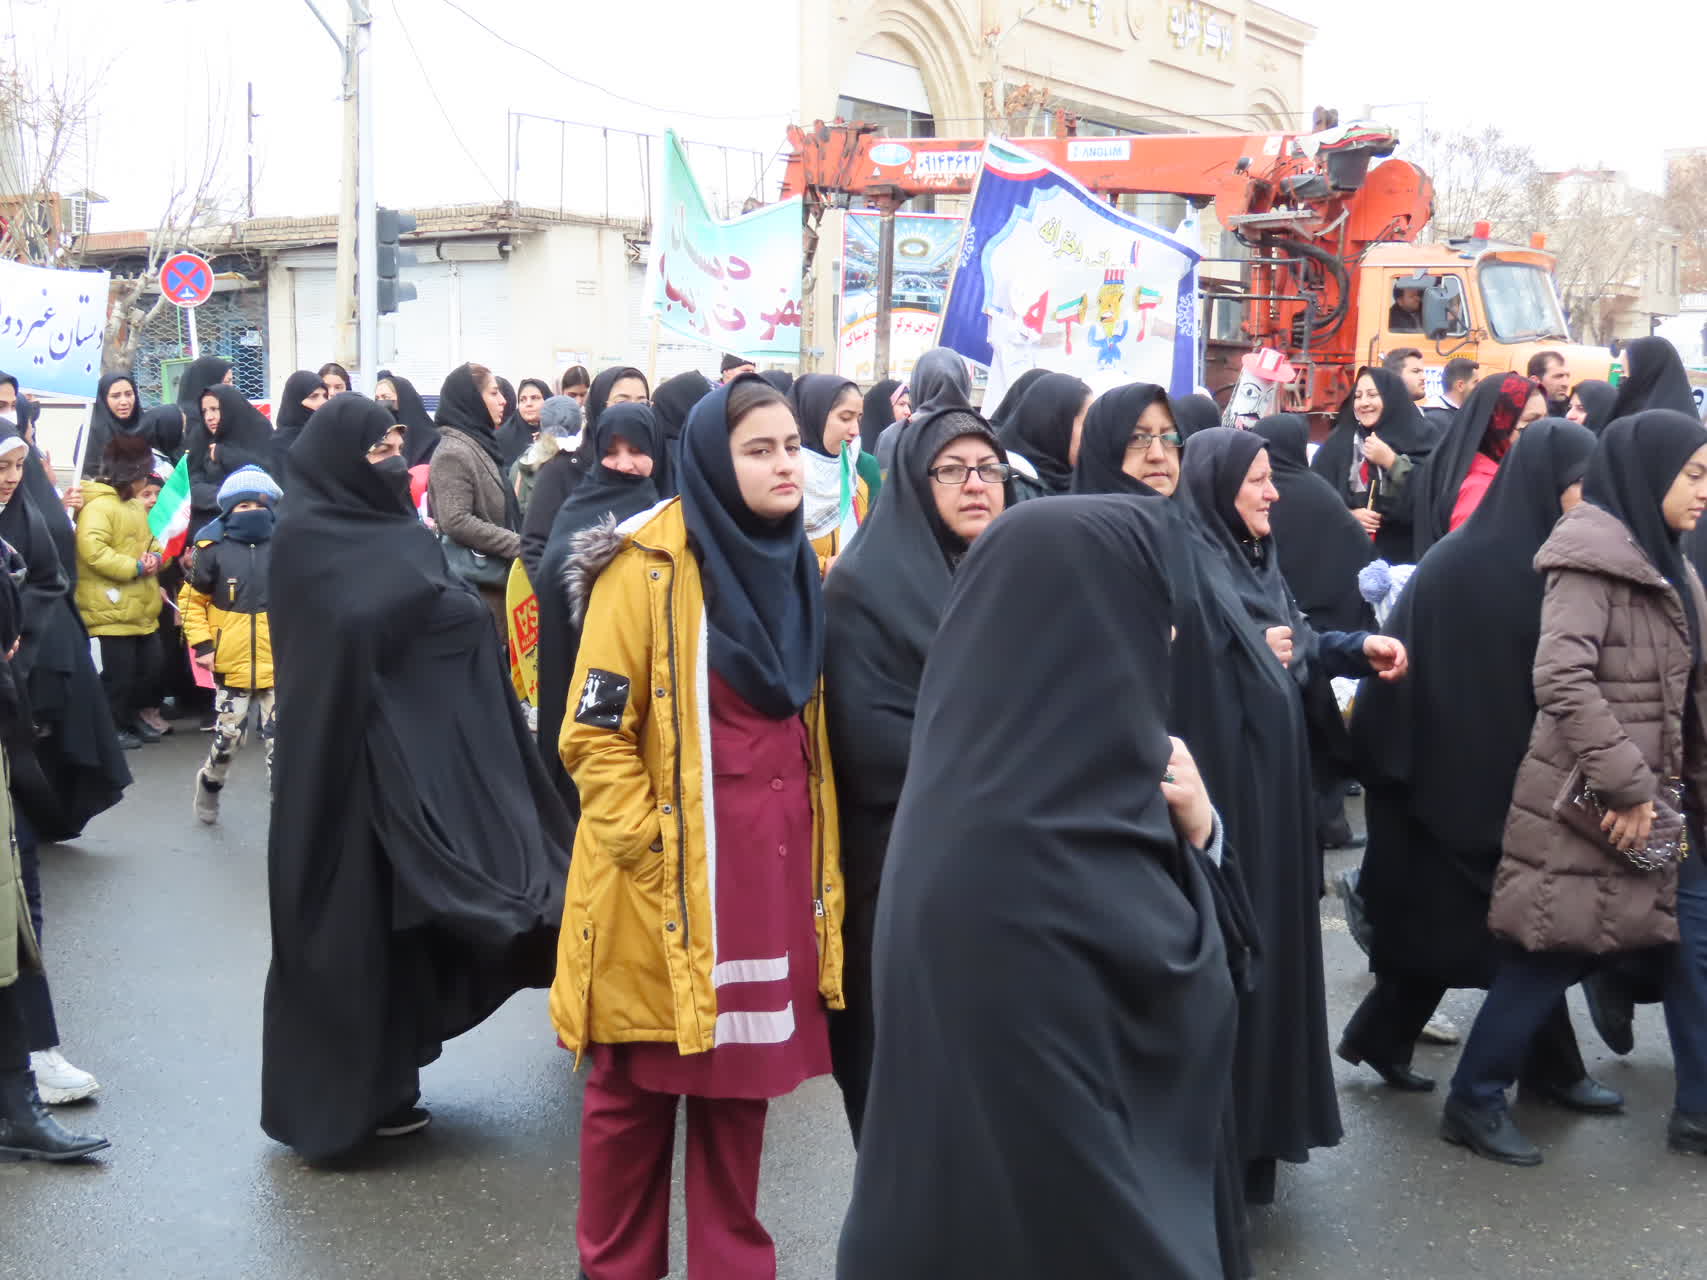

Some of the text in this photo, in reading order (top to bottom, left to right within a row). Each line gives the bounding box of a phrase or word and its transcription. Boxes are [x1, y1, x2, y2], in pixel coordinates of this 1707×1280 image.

[0, 287, 104, 373] دبستان غیردو
[516, 598, 538, 634] SA
